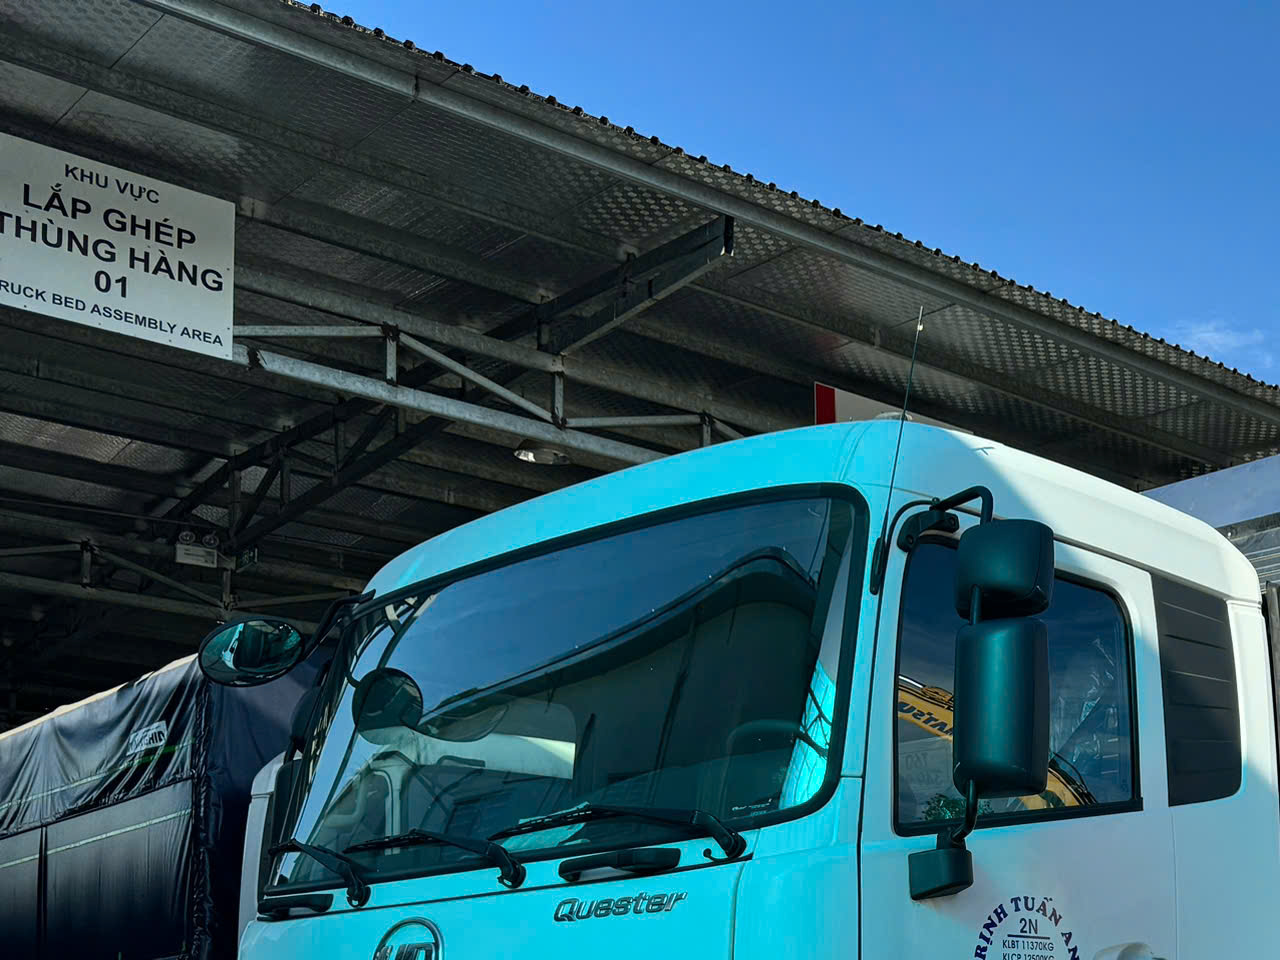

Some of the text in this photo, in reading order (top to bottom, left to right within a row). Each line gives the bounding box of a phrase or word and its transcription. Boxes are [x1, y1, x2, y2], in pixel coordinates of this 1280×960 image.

[65, 163, 160, 204] KHU VỰC
[23, 182, 196, 249] LẮP GHÉP
[0, 210, 224, 292] THÙNG HÀNG
[94, 270, 127, 299] 01
[52, 293, 86, 312] BED
[90, 304, 177, 335] ASSEMBLY
[180, 326, 224, 347] AREA
[552, 891, 688, 923] Quester
[1019, 918, 1039, 934] 2N
[1002, 940, 1055, 952] KLBT 11370KG
